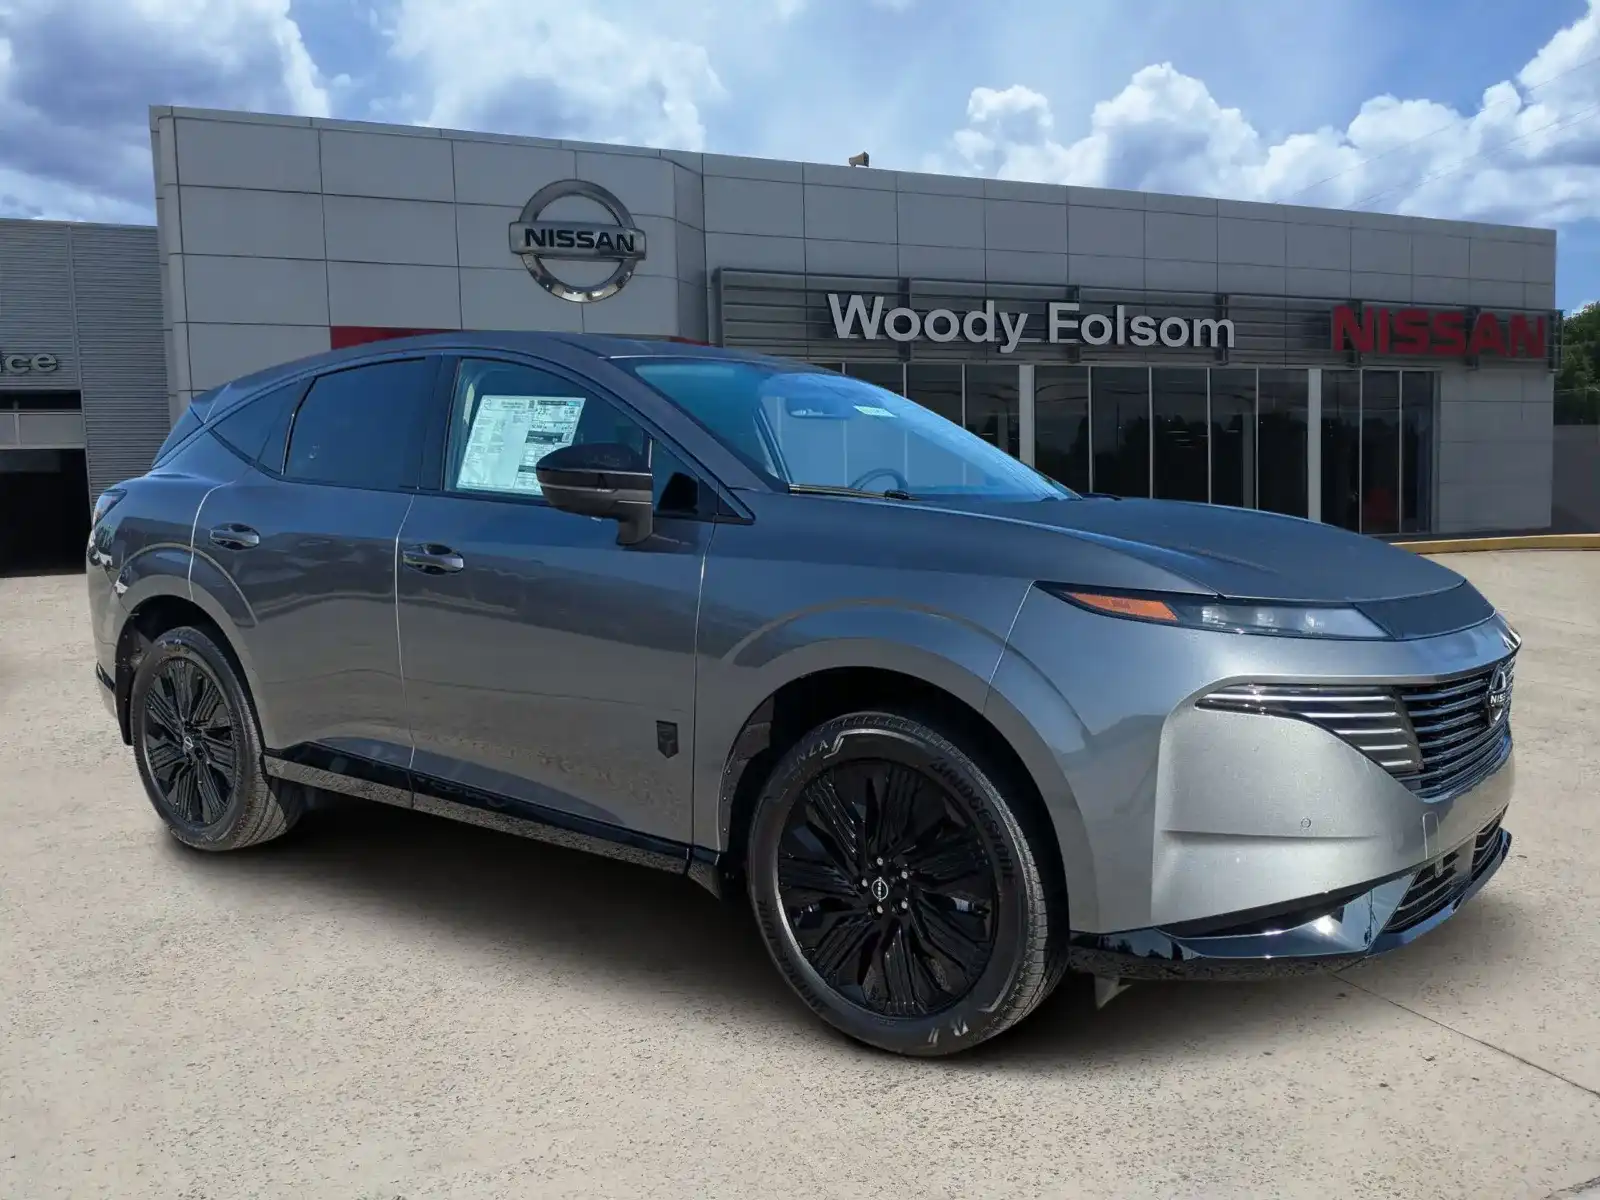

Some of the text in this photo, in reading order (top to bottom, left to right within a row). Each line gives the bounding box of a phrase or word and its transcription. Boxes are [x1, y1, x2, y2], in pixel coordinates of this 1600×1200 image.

[524, 228, 635, 253] NISSAN
[827, 293, 1236, 354] Woody Folsom
[1332, 304, 1547, 358] NISSAN
[0, 352, 57, 374] ce
